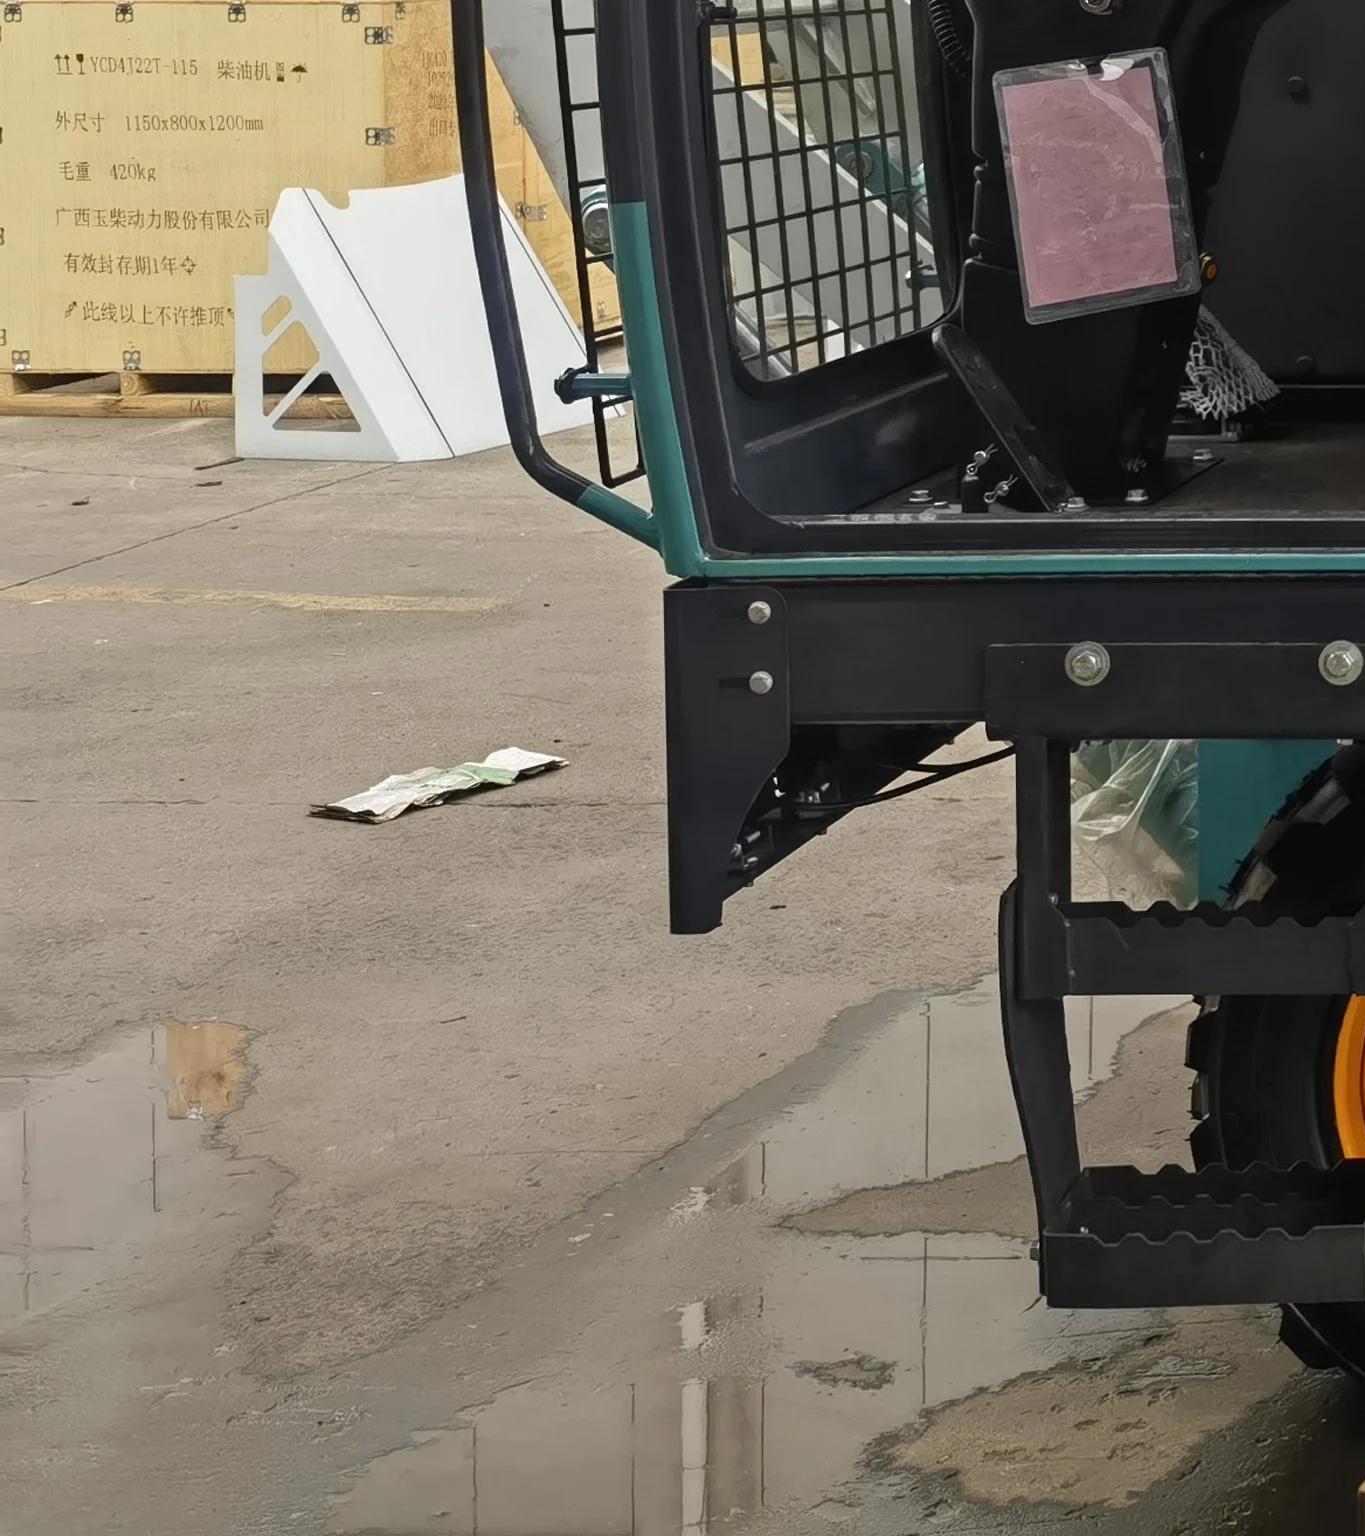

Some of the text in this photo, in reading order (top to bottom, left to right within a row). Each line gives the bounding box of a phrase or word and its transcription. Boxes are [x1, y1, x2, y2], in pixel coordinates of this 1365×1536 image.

[216, 59, 271, 81] 柴油机
[55, 110, 264, 133] 外尺寸 1150x800x1200mm
[58, 161, 156, 182] 毛重 420kg
[56, 207, 270, 230] 广西玉柴动力股份有限公司
[63, 252, 178, 276] 有效封存期1年
[82, 301, 225, 327] 此线以上不许推顶
